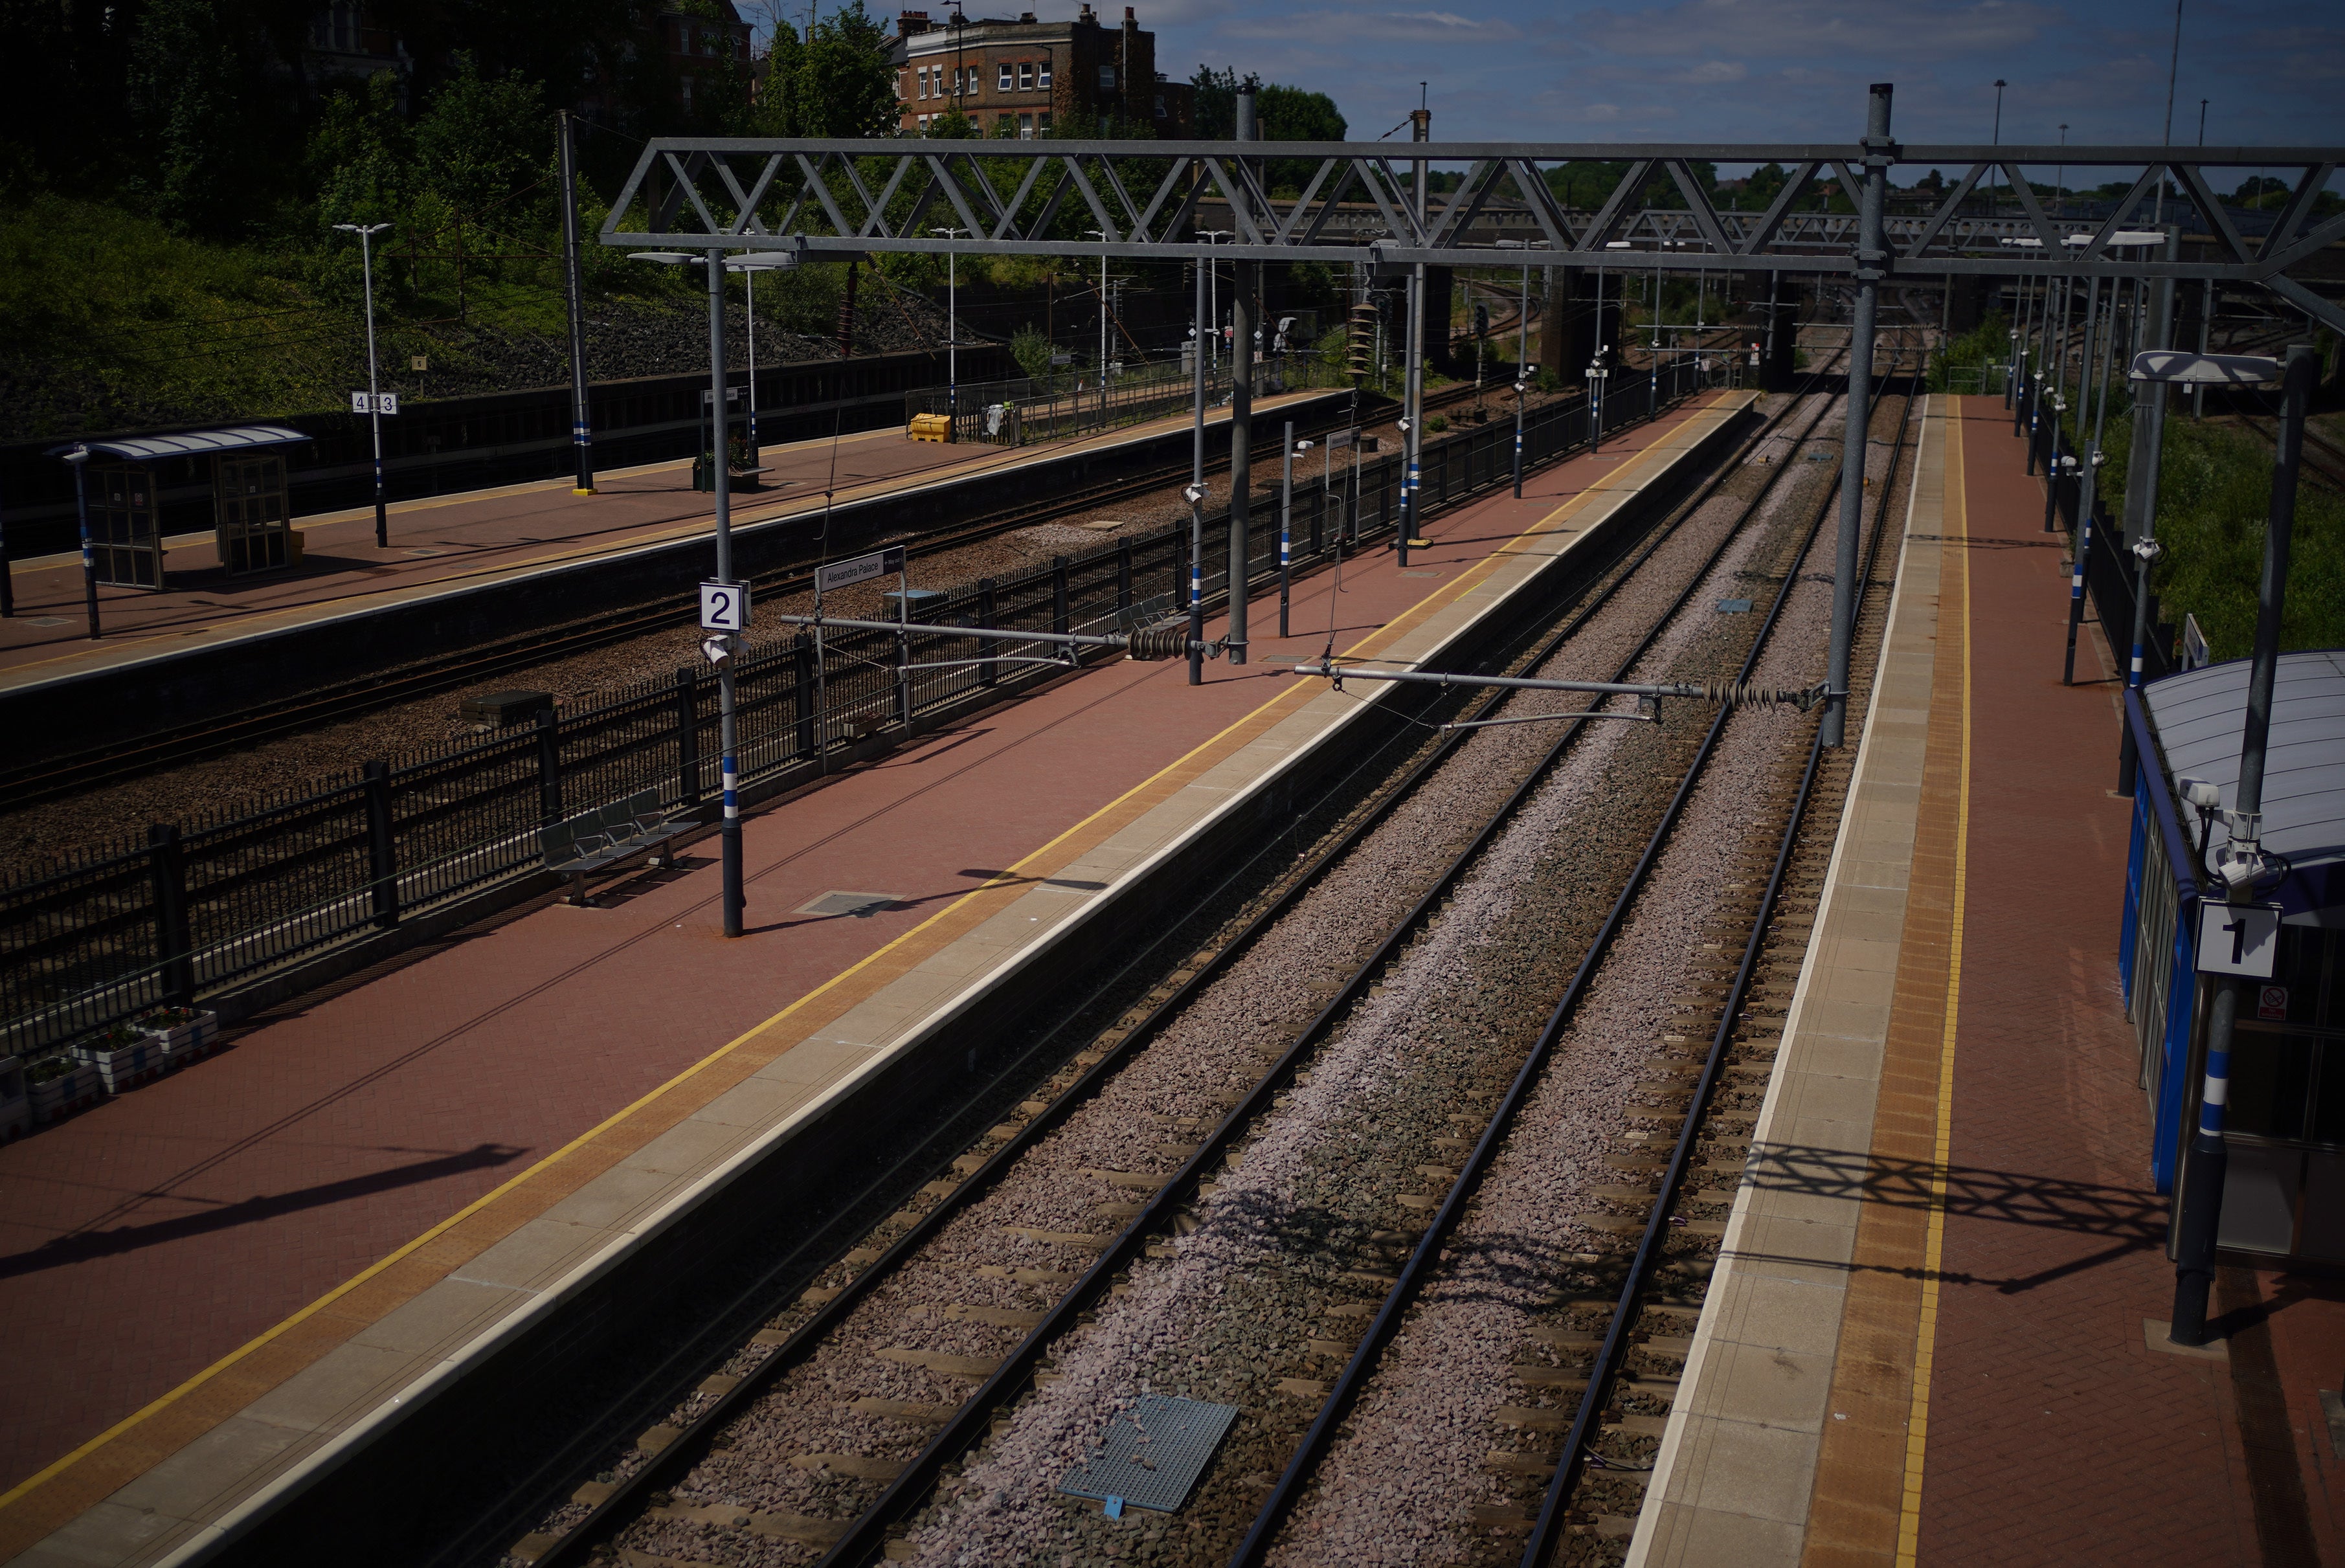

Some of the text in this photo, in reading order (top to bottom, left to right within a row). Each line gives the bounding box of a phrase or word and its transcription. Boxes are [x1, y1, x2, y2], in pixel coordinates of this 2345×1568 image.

[357, 396, 365, 409] 4
[384, 397, 392, 410] 3
[827, 563, 879, 583] Alexandra Palace
[711, 592, 730, 624] 2
[2223, 918, 2246, 965] 1
